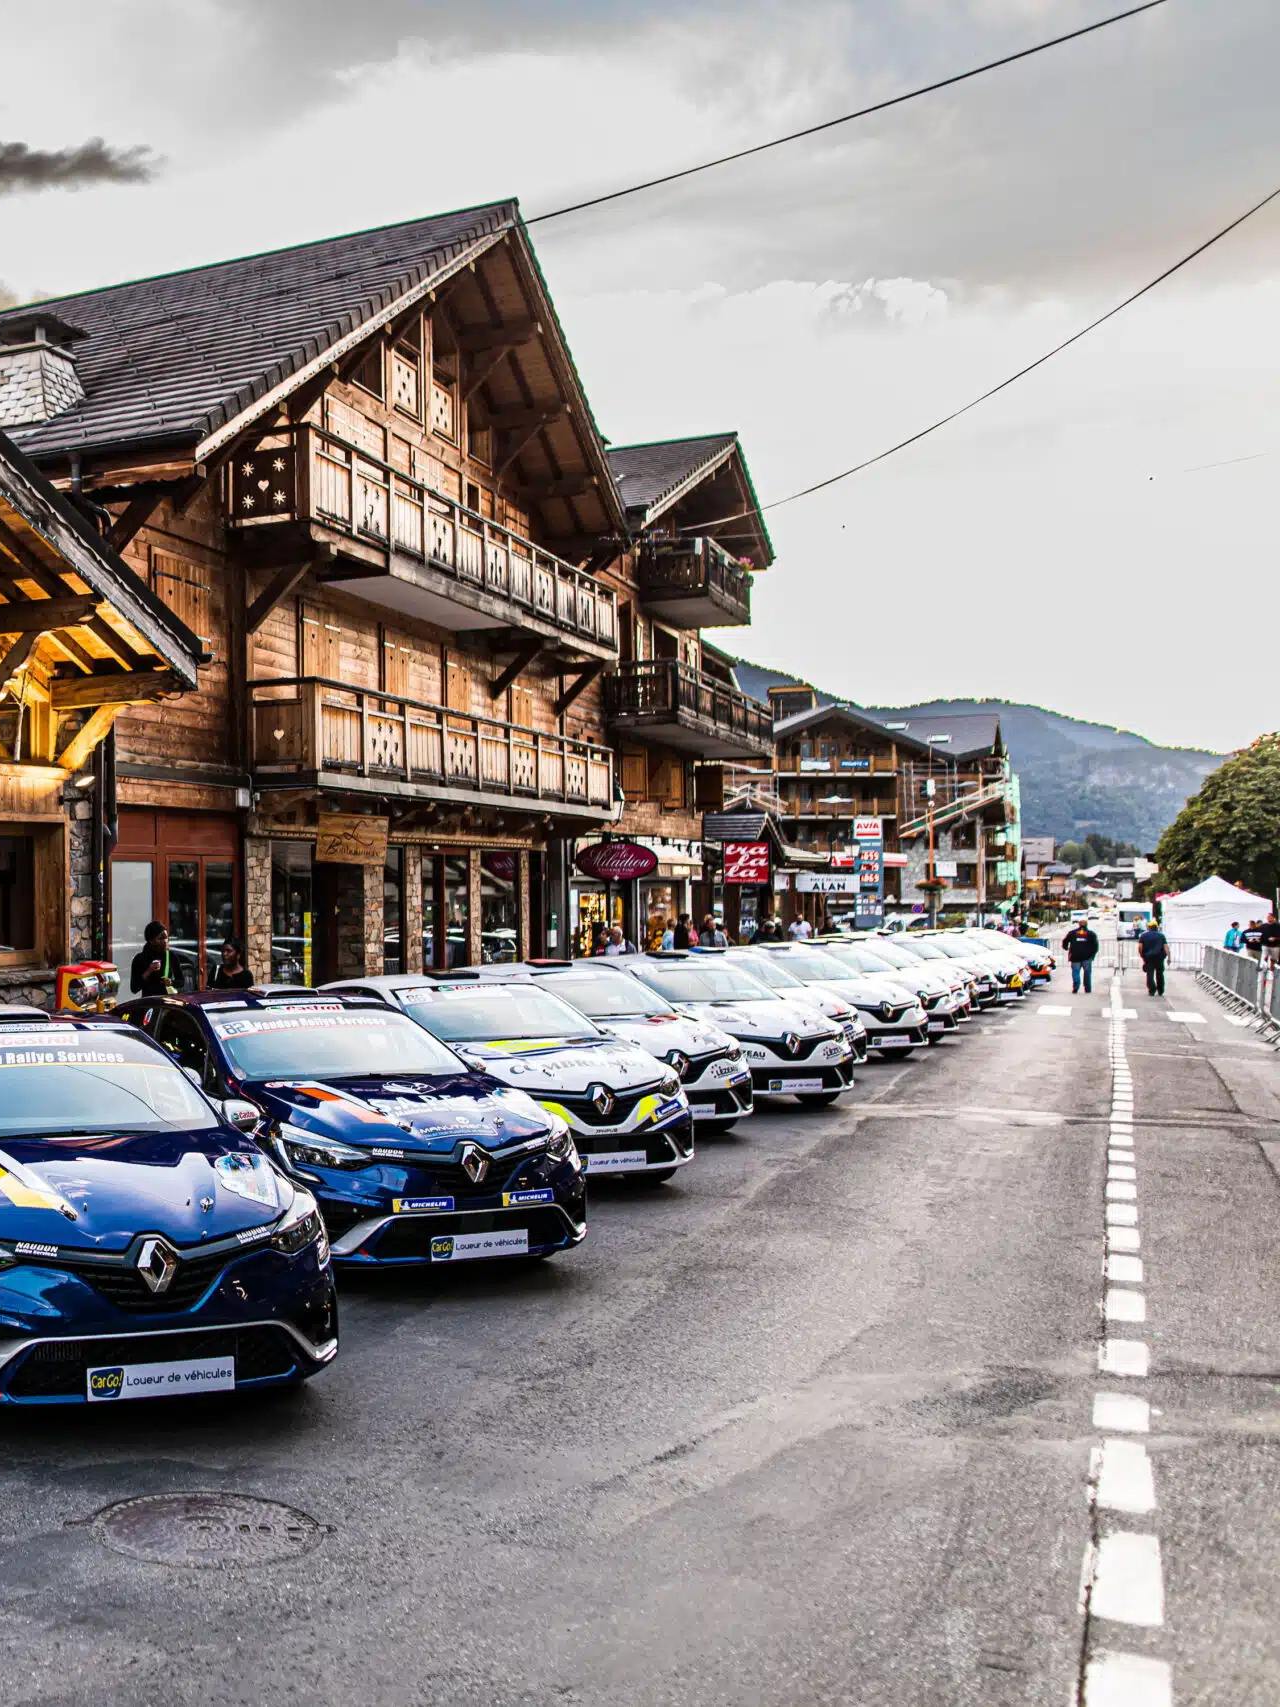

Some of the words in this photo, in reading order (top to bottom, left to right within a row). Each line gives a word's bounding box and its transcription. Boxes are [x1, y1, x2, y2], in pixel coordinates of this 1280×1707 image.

[725, 843, 768, 855] tra
[735, 853, 768, 867] la
[725, 865, 759, 878] la
[812, 882, 846, 891] ALAN
[286, 1004, 341, 1012] Castrol
[336, 1016, 387, 1026] Services
[223, 1022, 249, 1035] 82
[0, 1034, 74, 1046] Castrol
[5, 1052, 55, 1065] Rallye
[57, 1051, 125, 1063] Services
[518, 1193, 548, 1201] MICHELIN
[235, 1226, 268, 1241] NAUDON
[17, 1241, 59, 1253] NAUDON
[456, 1242, 481, 1250] Loueur
[483, 1240, 493, 1248] de
[495, 1237, 527, 1247] véhicules
[126, 1375, 165, 1386] Loueur
[167, 1372, 181, 1382] de
[185, 1368, 232, 1380] véhicules
